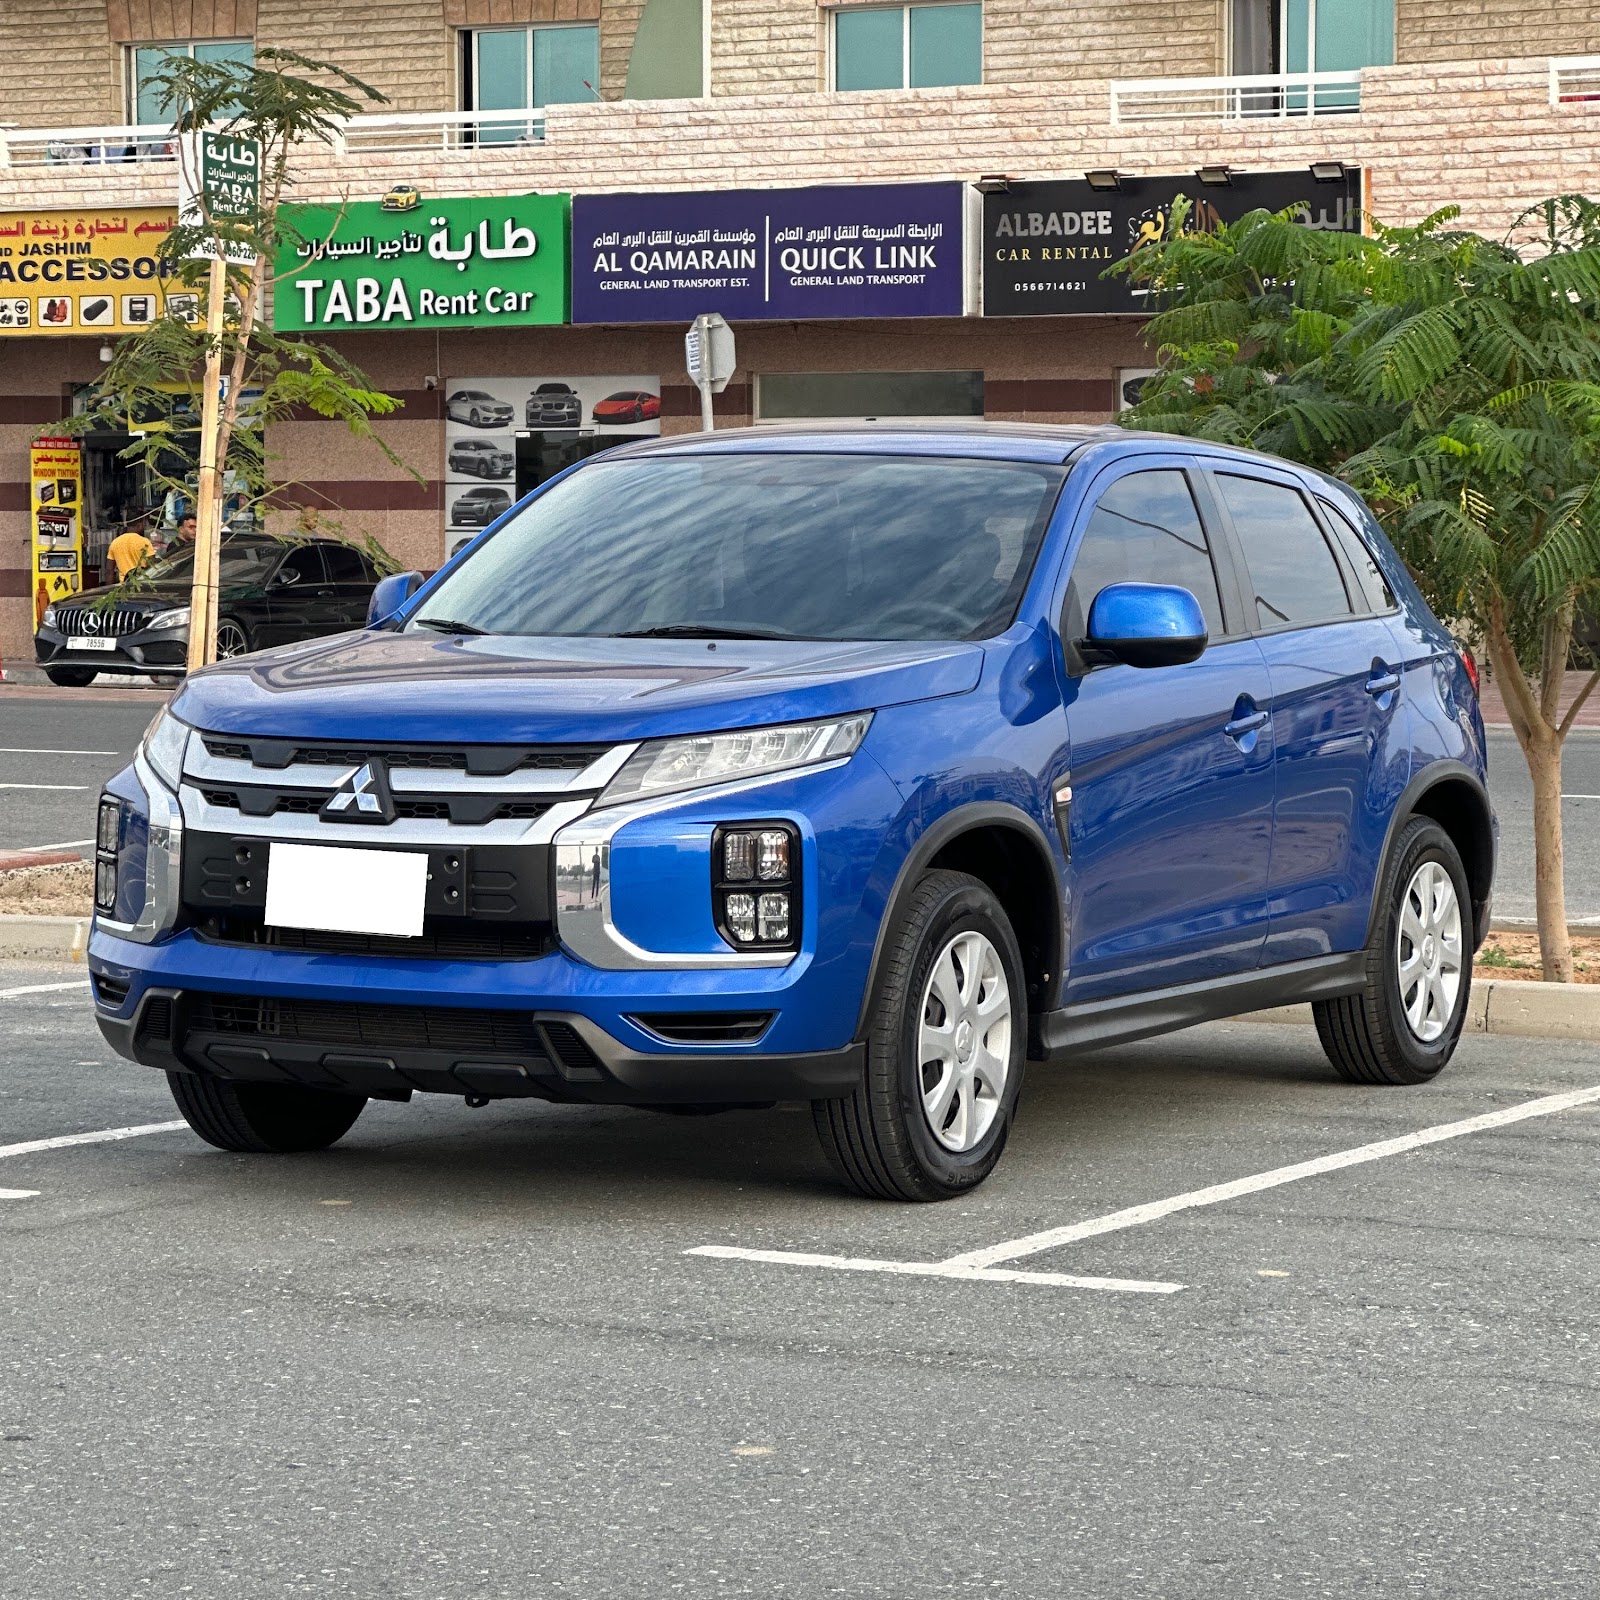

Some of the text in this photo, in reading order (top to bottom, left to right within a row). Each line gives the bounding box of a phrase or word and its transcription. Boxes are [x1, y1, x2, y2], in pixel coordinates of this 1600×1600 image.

[206, 179, 255, 206] TABA
[212, 200, 250, 215] Rent Car
[31, 218, 69, 240] زينة
[74, 217, 127, 240] لتجارة
[774, 223, 943, 244] الرابطة السريعة للنقل البري العام
[995, 210, 1113, 237] ALBADEE
[18, 242, 92, 256] JASHIM
[374, 229, 422, 259] لتأجير
[427, 216, 538, 272] طابة
[593, 228, 756, 249] مؤسسة القمرين للنقل البري العام
[593, 249, 756, 274] AL QAMARAIN
[780, 245, 937, 274] QUICK LINK
[996, 246, 1113, 261] CAR RENTAL
[600, 278, 750, 290] GENERAL LAND TRANSPORT EST.
[790, 274, 926, 286] GENERAL LAND TRANSPORT
[1014, 281, 1086, 291] 0566714621
[295, 277, 534, 323] TABA Rent Car
[33, 468, 79, 477] WINDOW TINTING
